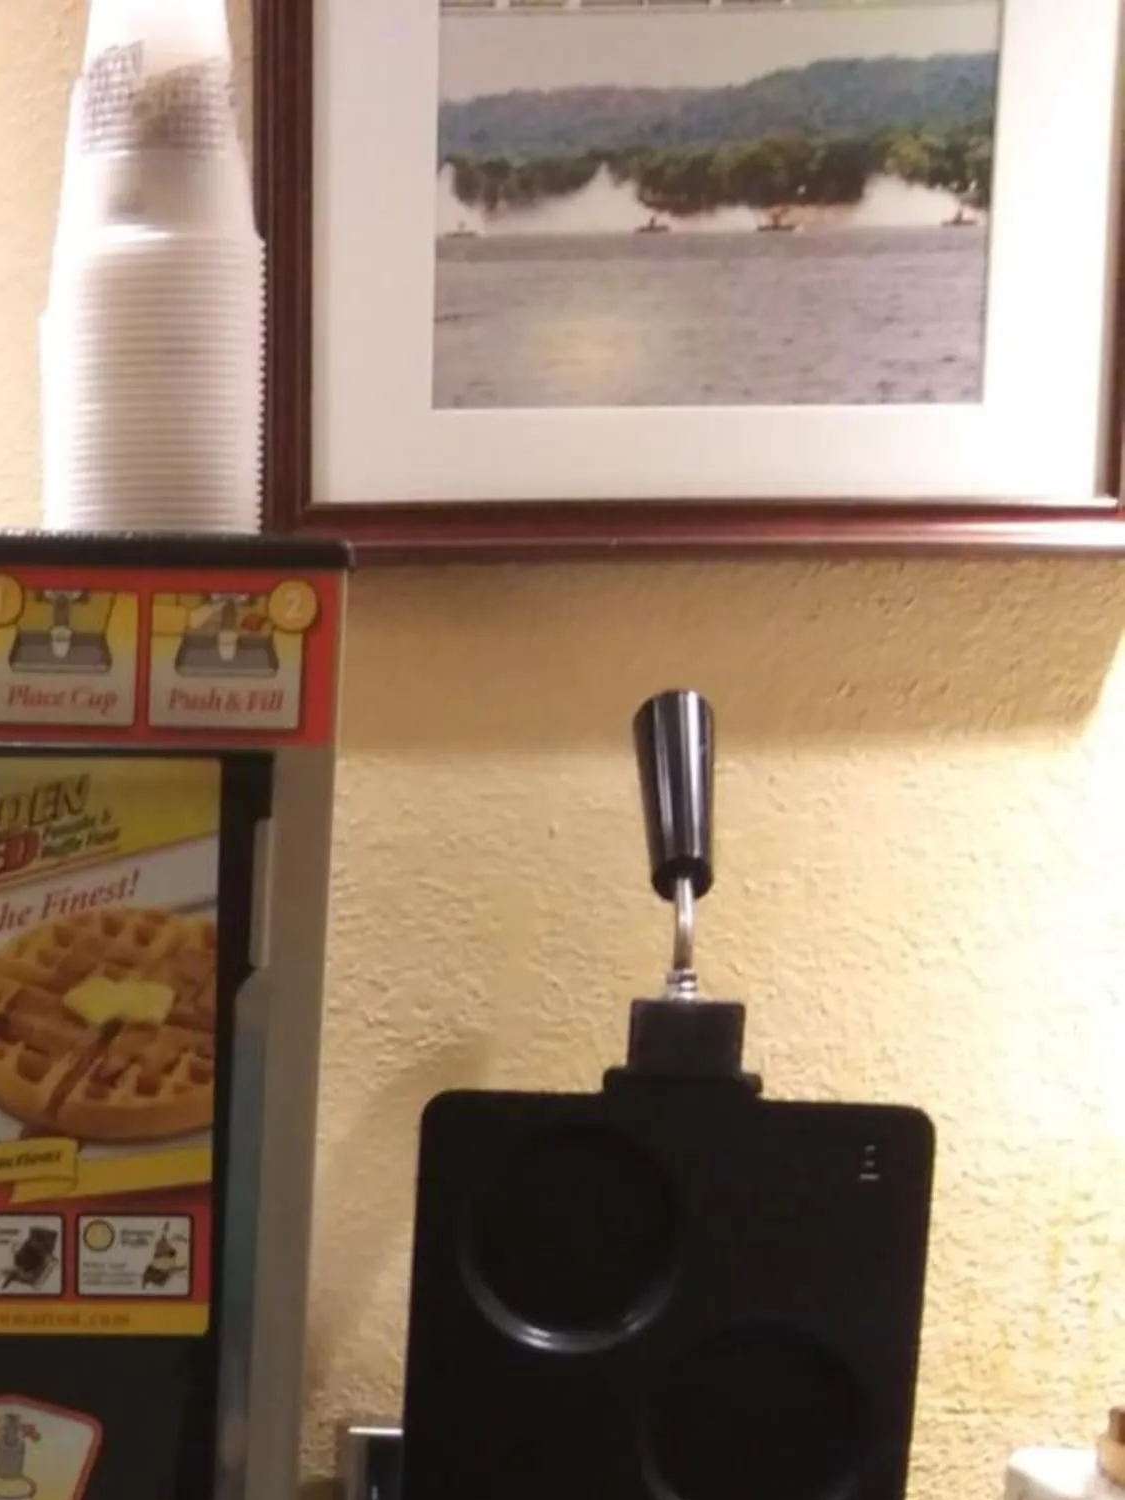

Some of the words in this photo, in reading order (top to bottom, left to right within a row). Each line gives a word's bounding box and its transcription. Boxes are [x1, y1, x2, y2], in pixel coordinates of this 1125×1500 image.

[8, 685, 64, 707] Place
[71, 688, 118, 714] Cup
[168, 688, 221, 712] Push
[225, 693, 242, 713] &
[245, 690, 284, 713] Fill
[41, 869, 141, 922] Finest!
